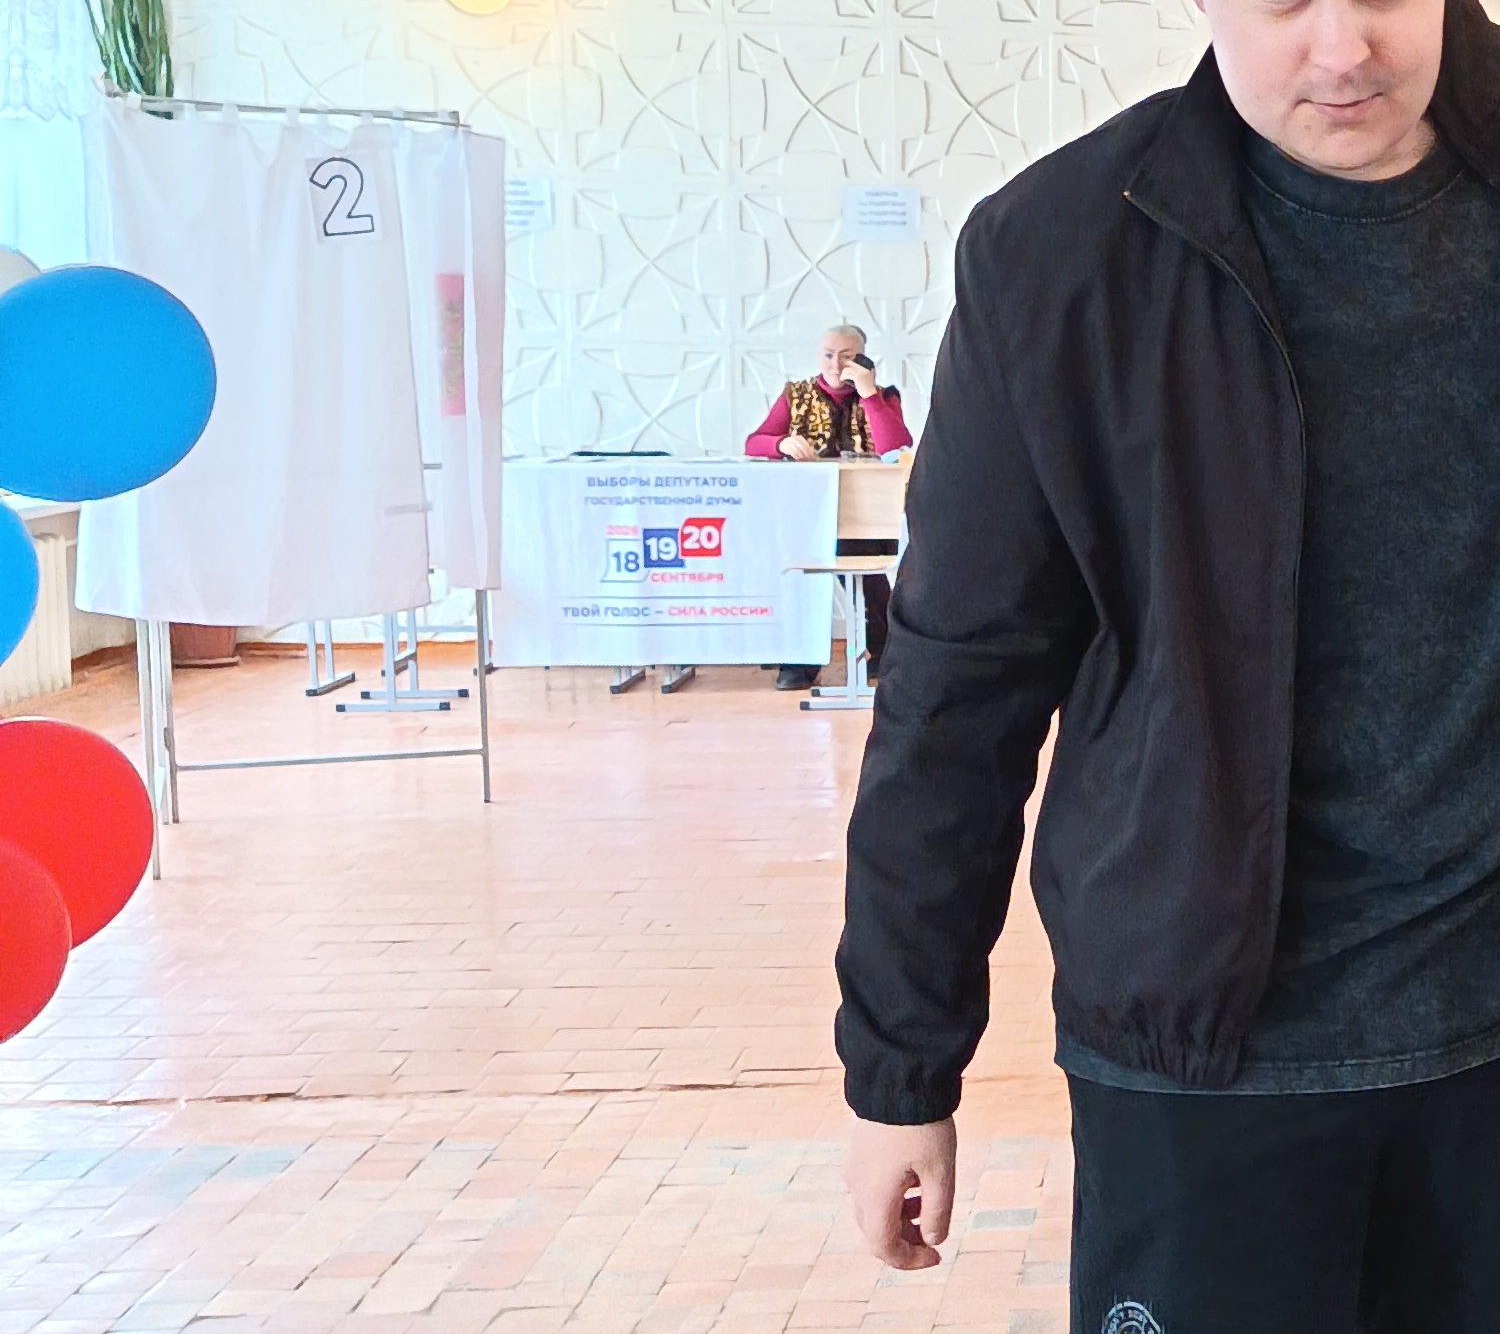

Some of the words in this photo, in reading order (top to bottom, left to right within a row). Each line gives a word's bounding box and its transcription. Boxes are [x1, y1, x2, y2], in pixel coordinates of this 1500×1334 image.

[309, 157, 375, 237] 2
[587, 476, 650, 487] ВЫБОРЫ
[654, 476, 739, 487] ДЕПУТАТОВ
[583, 494, 703, 506] ГОСУДАРСТВЕННОЙ
[705, 496, 743, 506] ДУМЫ
[682, 525, 720, 550] 20
[645, 537, 677, 561] 19
[611, 550, 640, 573] 18
[650, 572, 726, 583] СЕНТЯБРЯ
[562, 603, 601, 617] ТВОЙ
[604, 606, 650, 618] ГОЛОС
[667, 606, 707, 618] СИЛА
